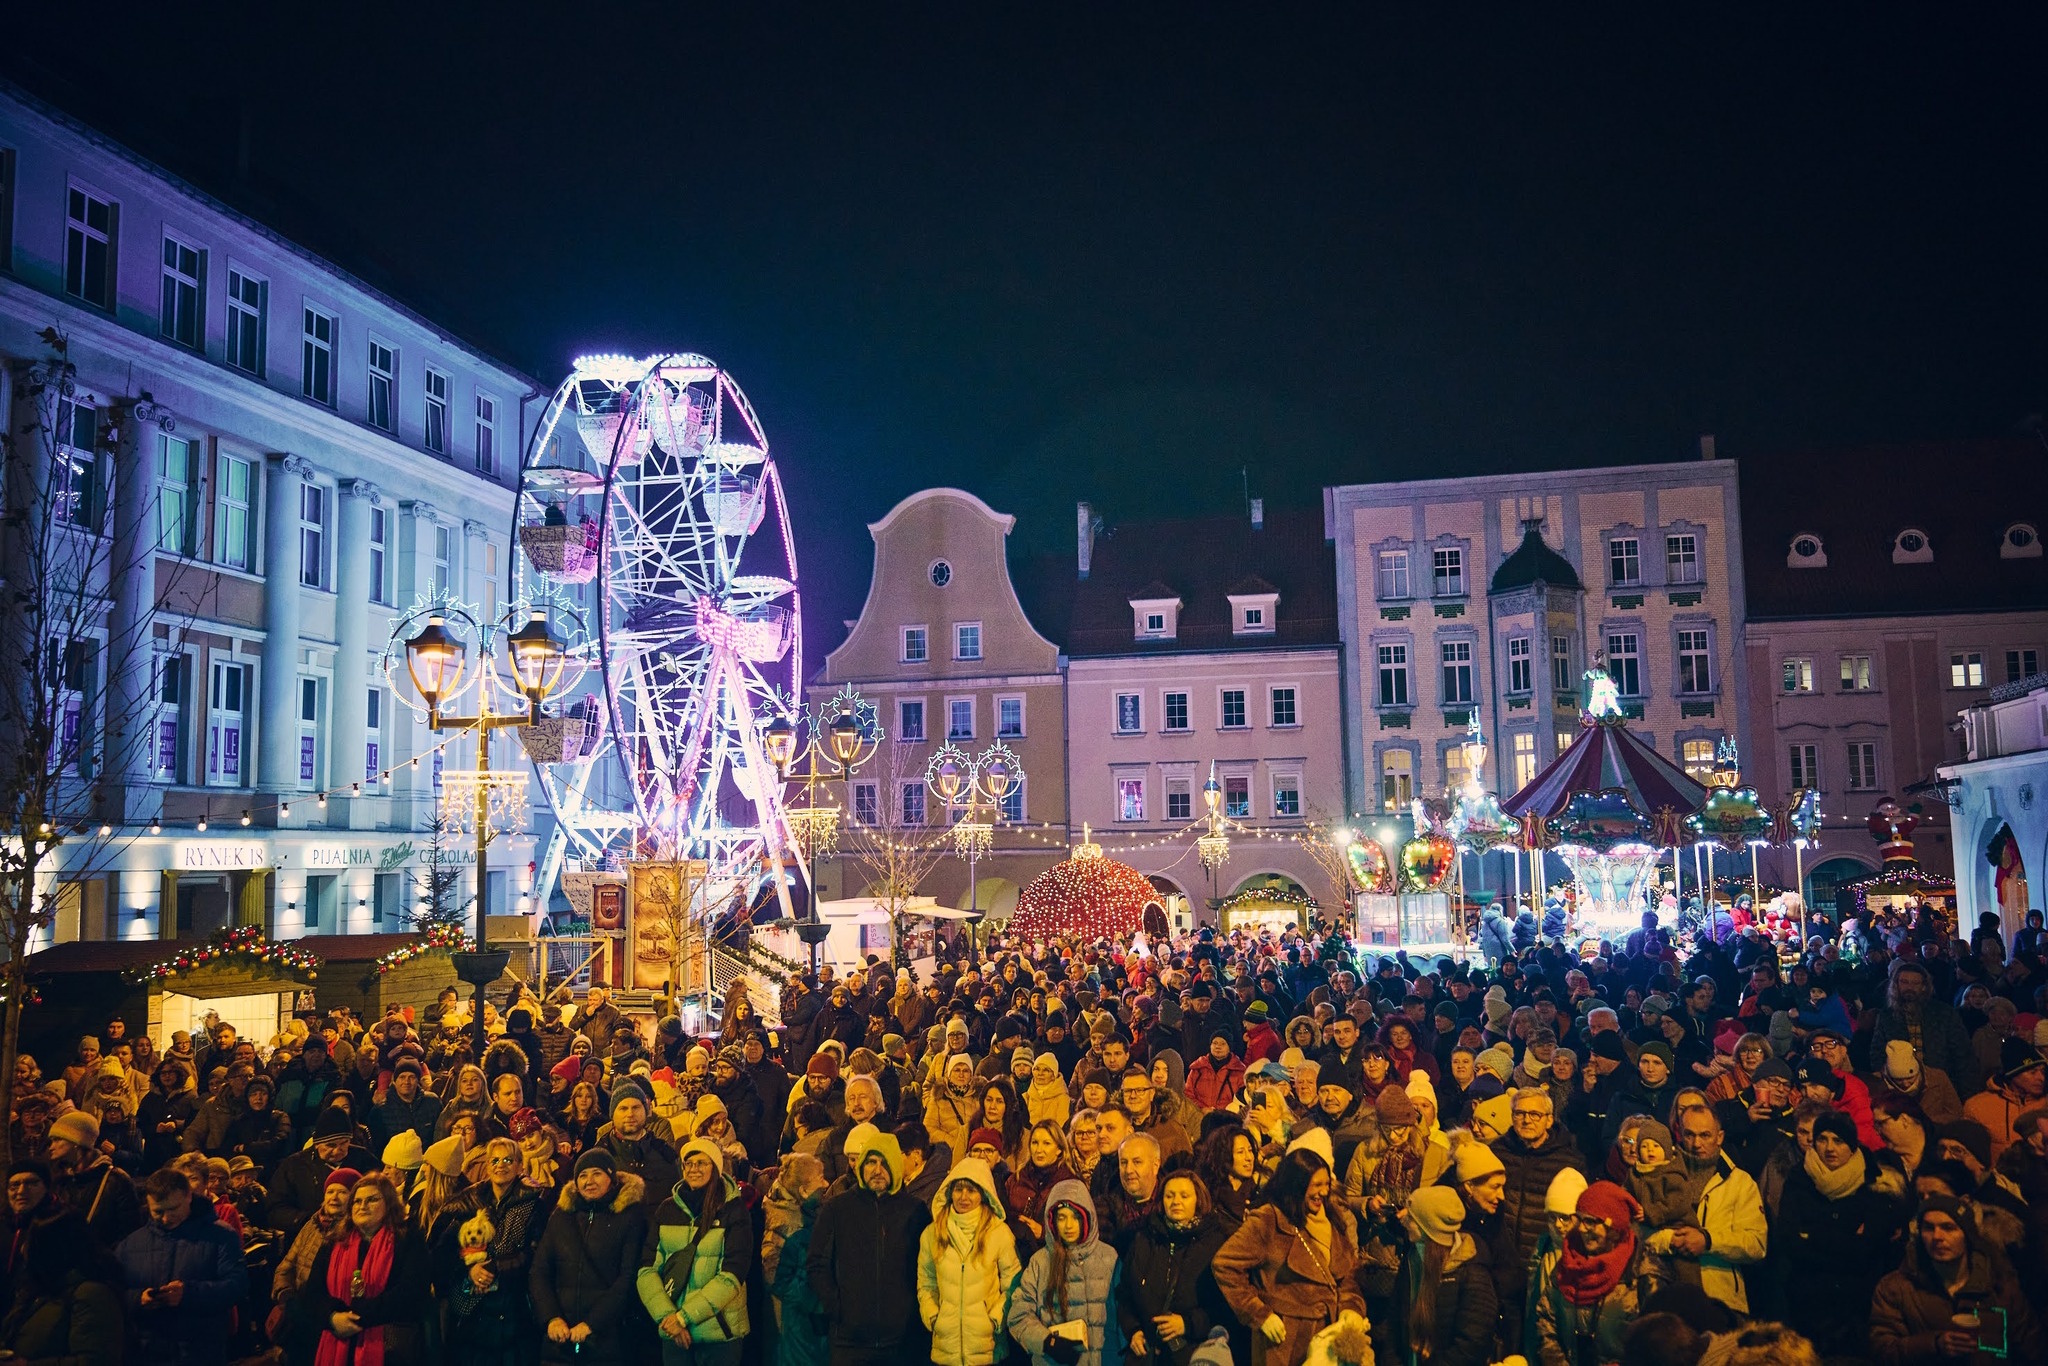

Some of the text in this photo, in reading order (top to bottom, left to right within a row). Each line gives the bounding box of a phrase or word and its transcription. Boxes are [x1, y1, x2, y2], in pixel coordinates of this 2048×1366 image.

[185, 847, 264, 866] RYNEK 18
[313, 848, 373, 865] PIJALNIA
